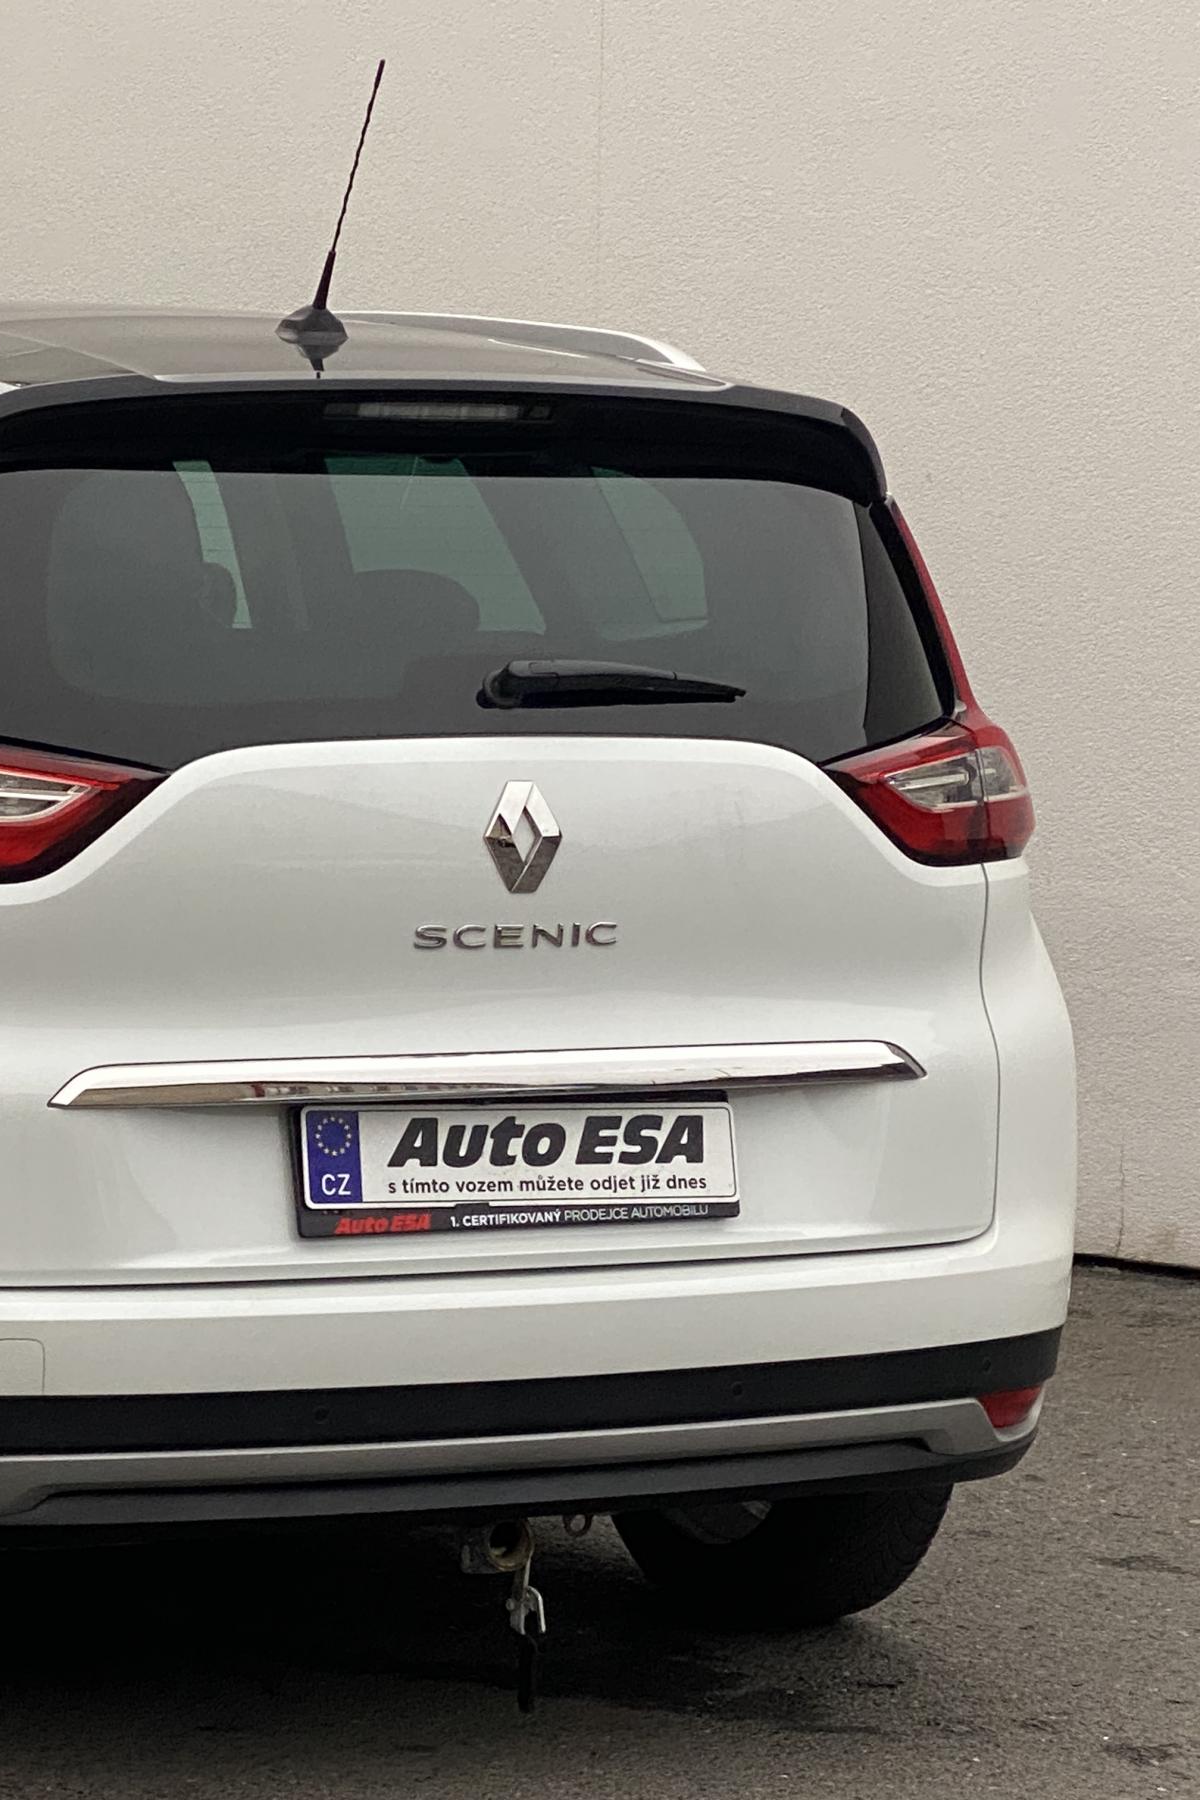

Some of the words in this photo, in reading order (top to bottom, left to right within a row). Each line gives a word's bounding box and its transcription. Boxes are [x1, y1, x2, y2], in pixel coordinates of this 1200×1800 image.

[413, 921, 618, 950] SCENIC
[387, 1116, 566, 1169] Auto
[574, 1114, 704, 1165] ESA
[321, 1173, 351, 1196] CZ
[388, 1181, 397, 1194] s
[402, 1178, 450, 1194] tímto
[455, 1180, 514, 1193] vozem
[519, 1174, 585, 1192] můžete
[590, 1175, 636, 1193] odjet
[640, 1174, 661, 1193] již
[666, 1174, 707, 1189] dnes
[333, 1216, 389, 1236] Auto
[390, 1212, 432, 1233] ESA
[450, 1215, 460, 1228] 1.
[462, 1208, 561, 1227] CERTIFIKOVANÝ
[564, 1206, 629, 1222] PRODEJCE
